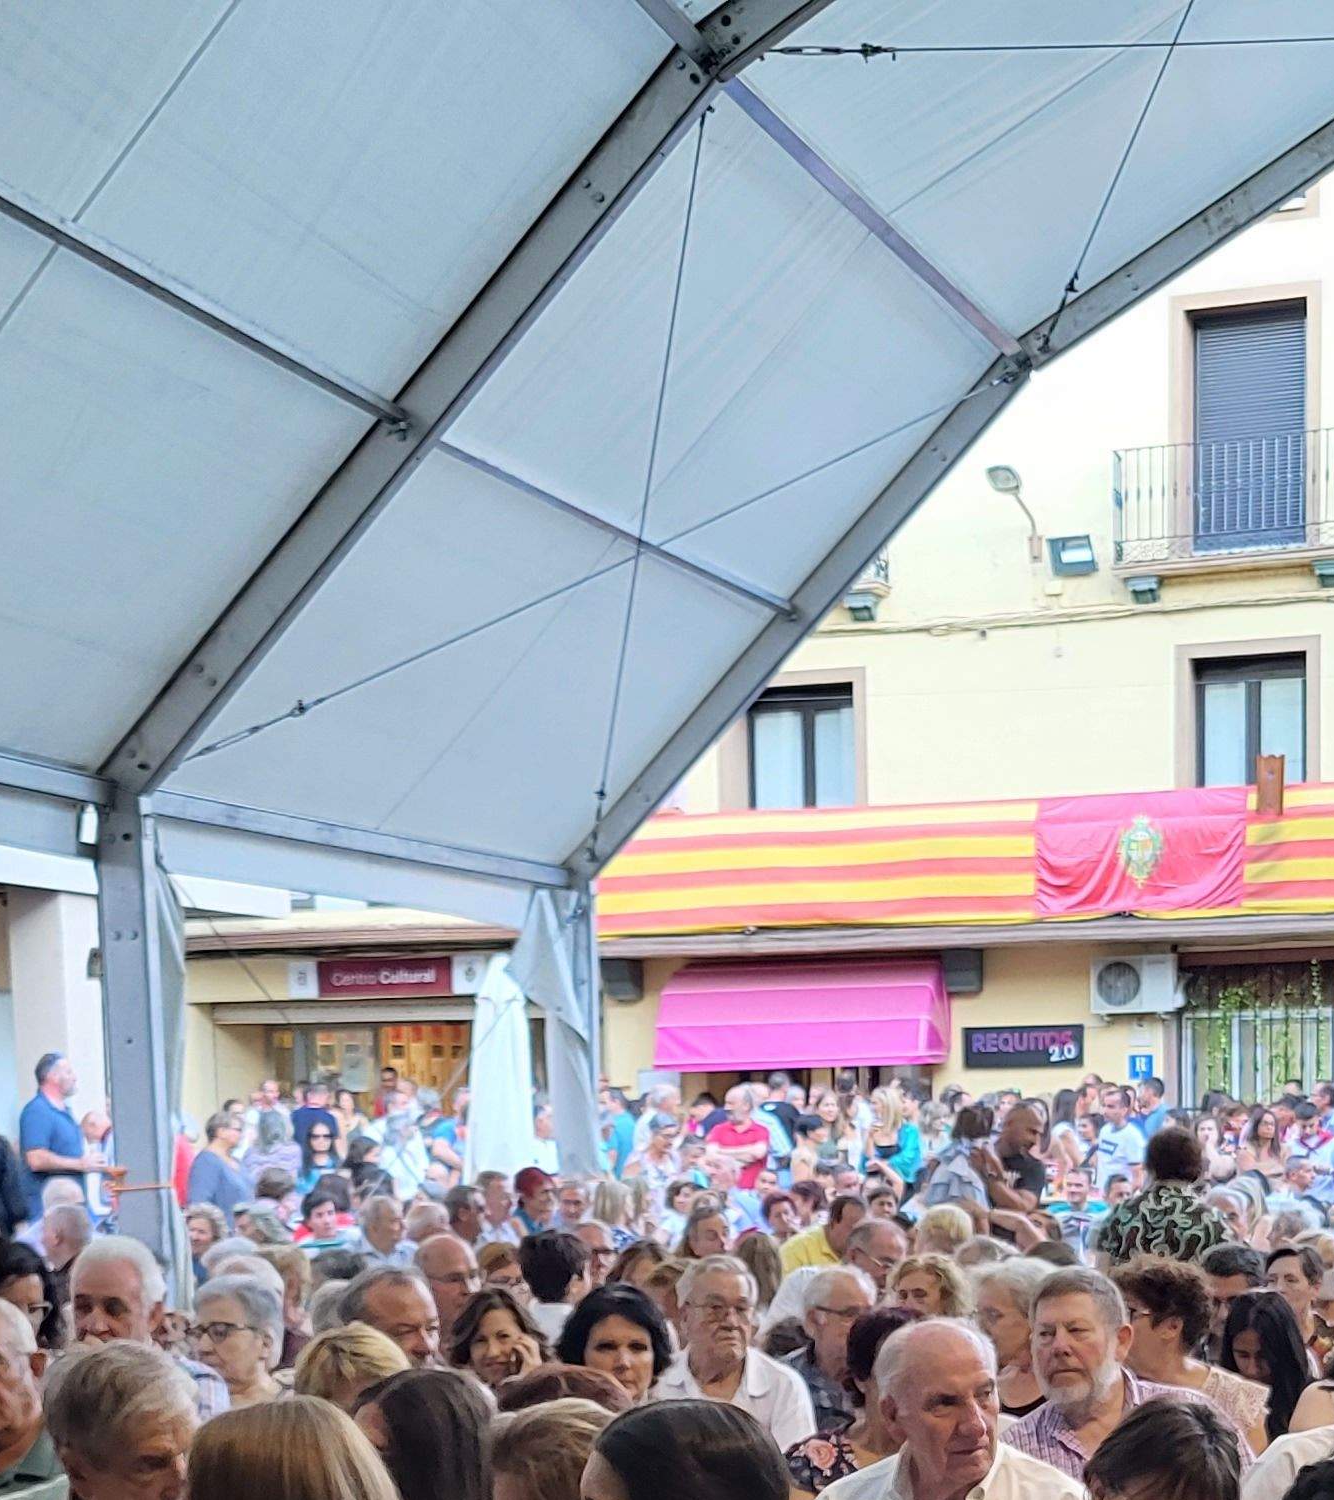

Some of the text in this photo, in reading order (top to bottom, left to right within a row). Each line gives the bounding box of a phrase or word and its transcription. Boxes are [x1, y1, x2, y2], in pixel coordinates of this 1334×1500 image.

[330, 967, 436, 987] Centro Cultural
[1048, 1043, 1078, 1063] 2.0
